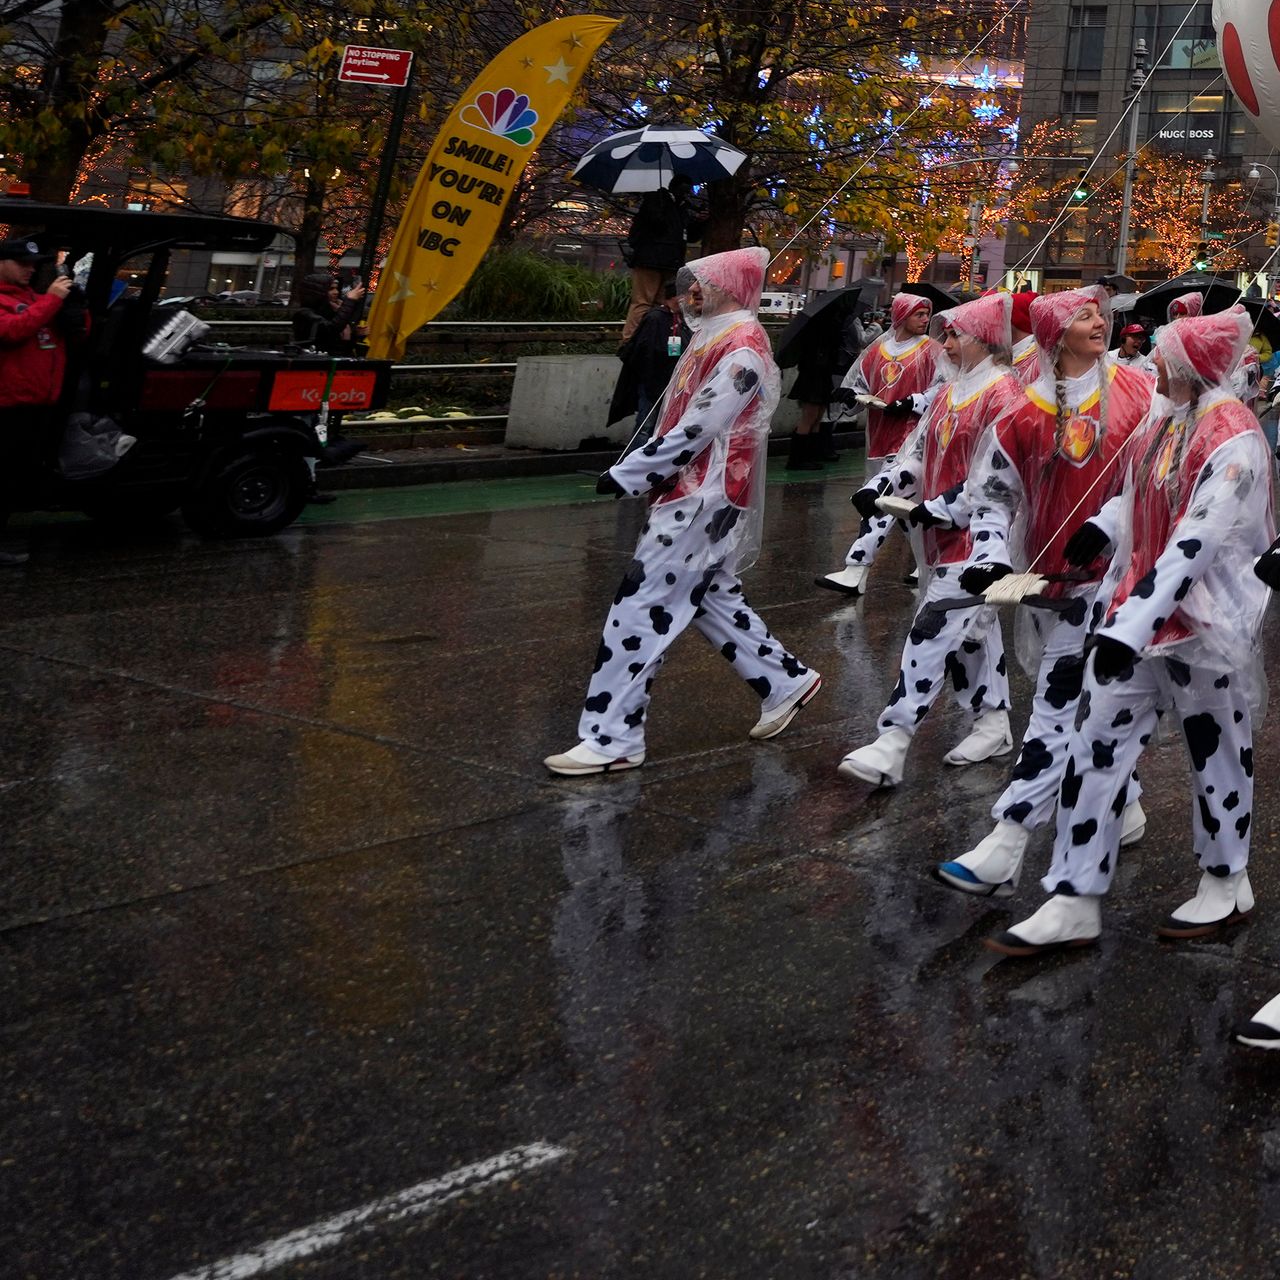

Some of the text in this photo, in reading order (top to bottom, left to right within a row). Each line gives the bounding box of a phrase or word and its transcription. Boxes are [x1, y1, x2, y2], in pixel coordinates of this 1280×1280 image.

[347, 57, 380, 67] Anytime
[348, 49, 401, 61] NO STOPPING
[1189, 130, 1214, 139] BOSS
[444, 137, 514, 176] SMILE!
[428, 163, 505, 207] YOU'RE
[431, 200, 472, 227] ON
